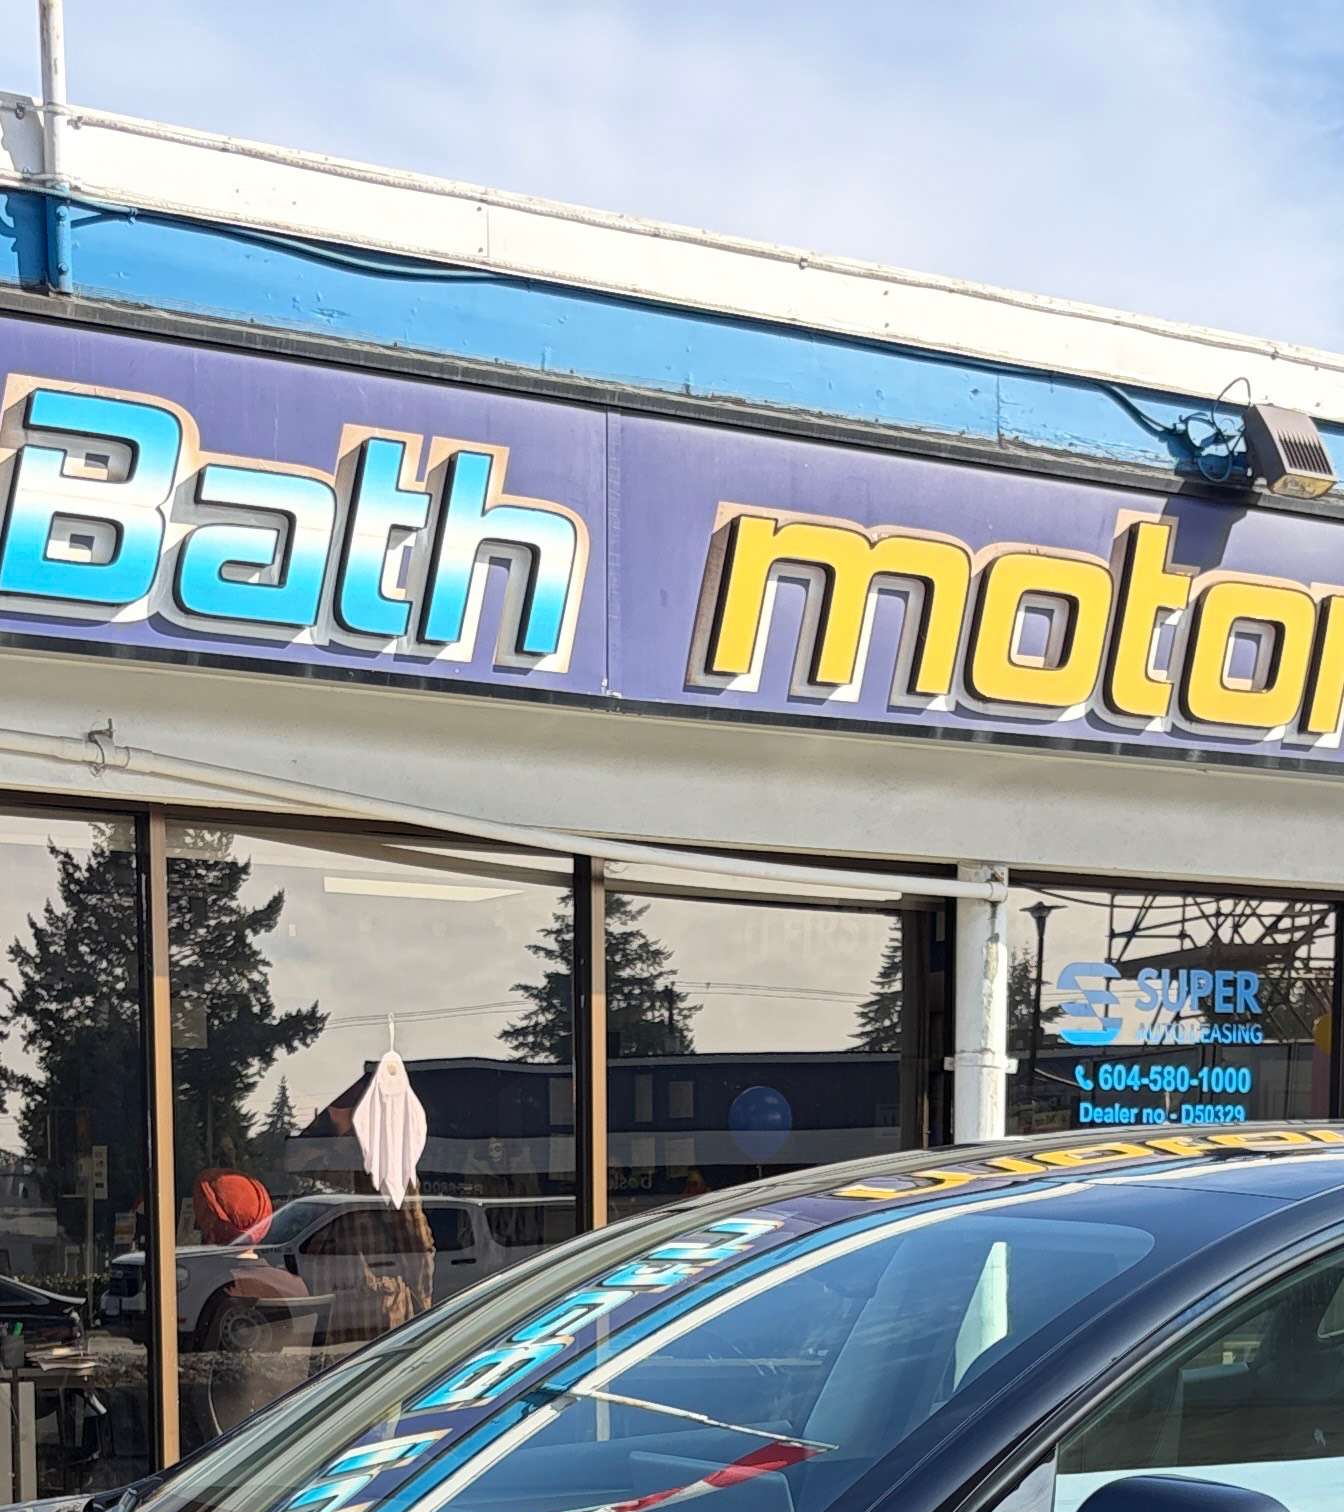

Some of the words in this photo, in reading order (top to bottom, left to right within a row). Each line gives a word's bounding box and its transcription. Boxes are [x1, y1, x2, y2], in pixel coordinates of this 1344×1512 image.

[1135, 967, 1263, 1014] SUPER
[1098, 1063, 1252, 1094] 604-580-1000
[1079, 1102, 1138, 1124] Dealer
[1181, 1104, 1246, 1124] D50329
